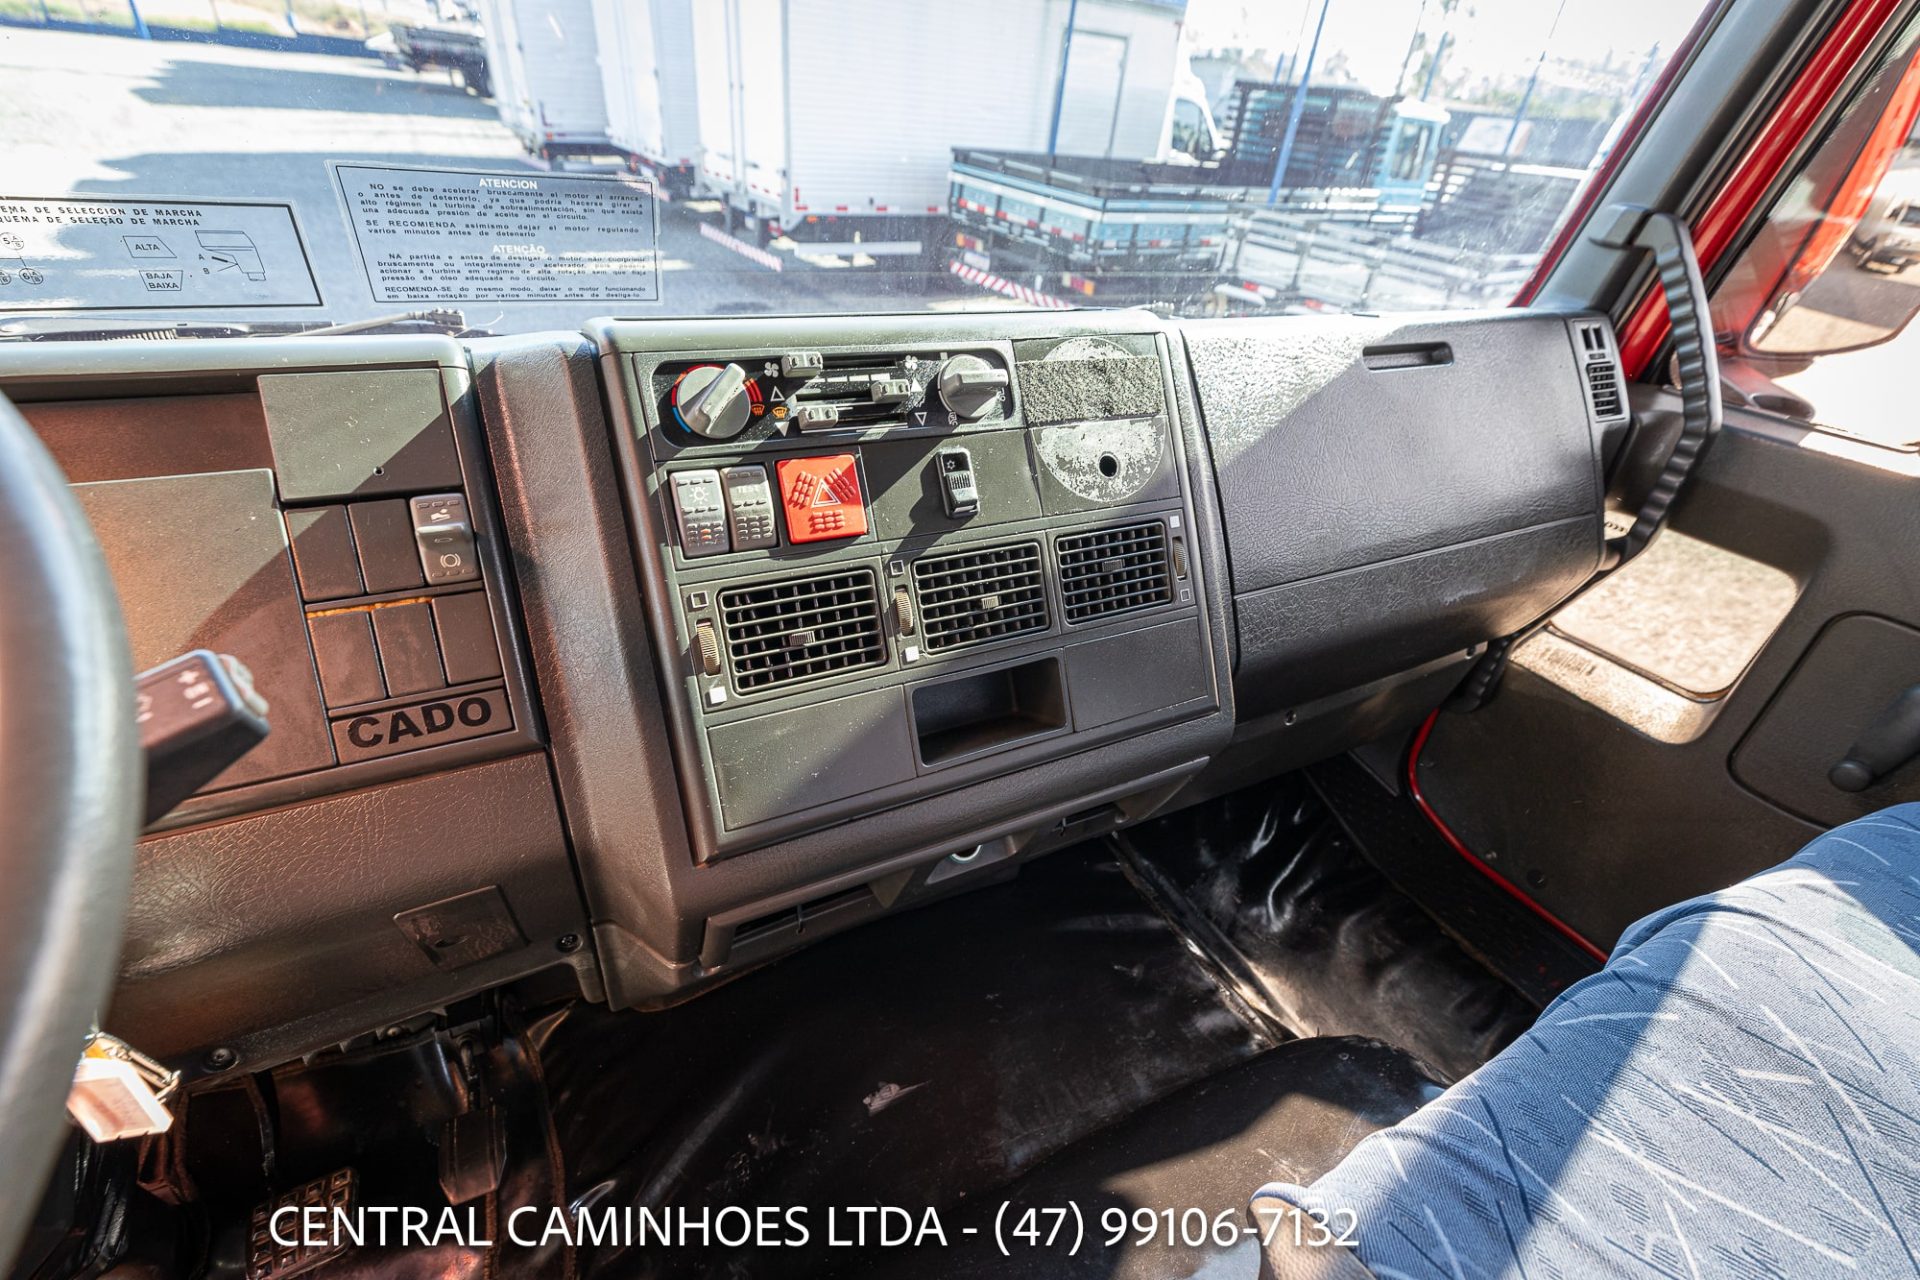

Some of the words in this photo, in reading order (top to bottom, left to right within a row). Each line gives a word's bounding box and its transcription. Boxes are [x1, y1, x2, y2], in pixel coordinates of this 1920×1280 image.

[479, 178, 538, 190] ATENCION
[58, 207, 126, 215] SELECCION
[70, 215, 123, 225] SELEÇÃO
[153, 218, 200, 226] MARCHA
[347, 697, 492, 748] CADO
